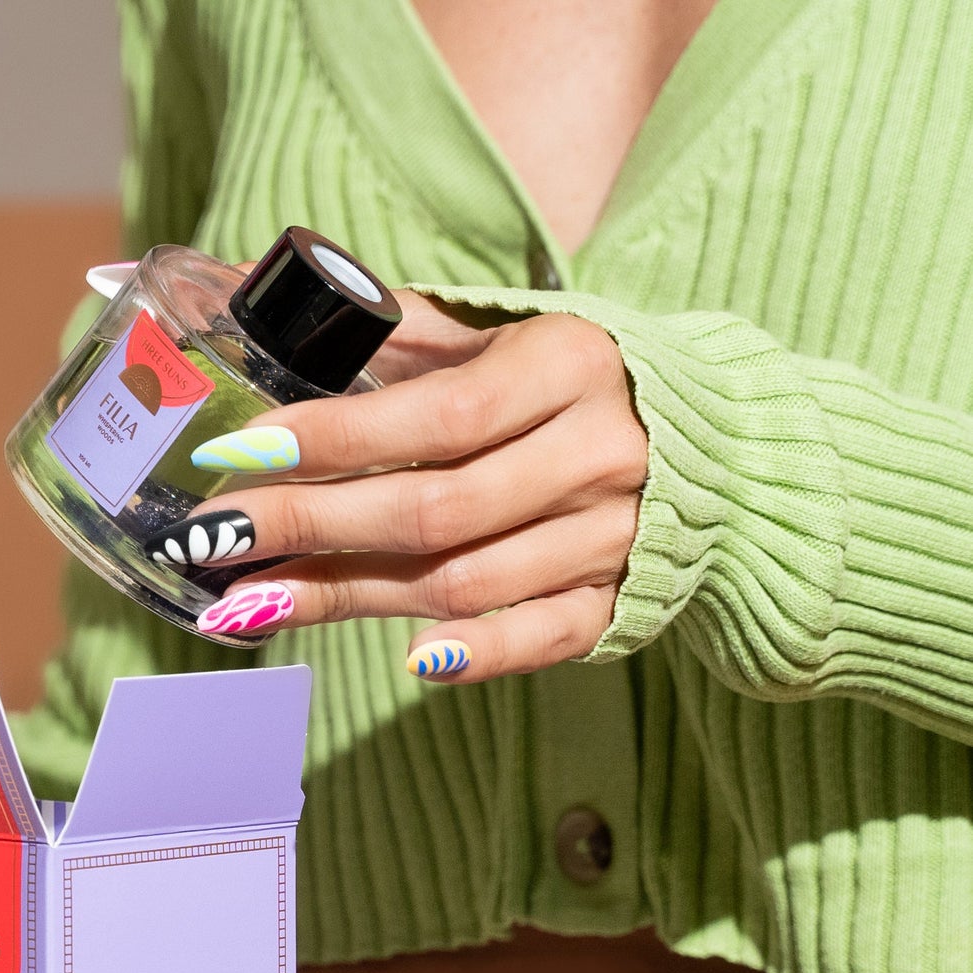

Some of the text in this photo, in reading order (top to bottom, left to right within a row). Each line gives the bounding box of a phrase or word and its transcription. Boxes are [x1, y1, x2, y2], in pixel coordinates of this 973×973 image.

[139, 336, 188, 390] HREE SUNS
[97, 413, 125, 443] WHISPERING
[97, 425, 114, 445] WOODS
[99, 392, 138, 440] FILIA
